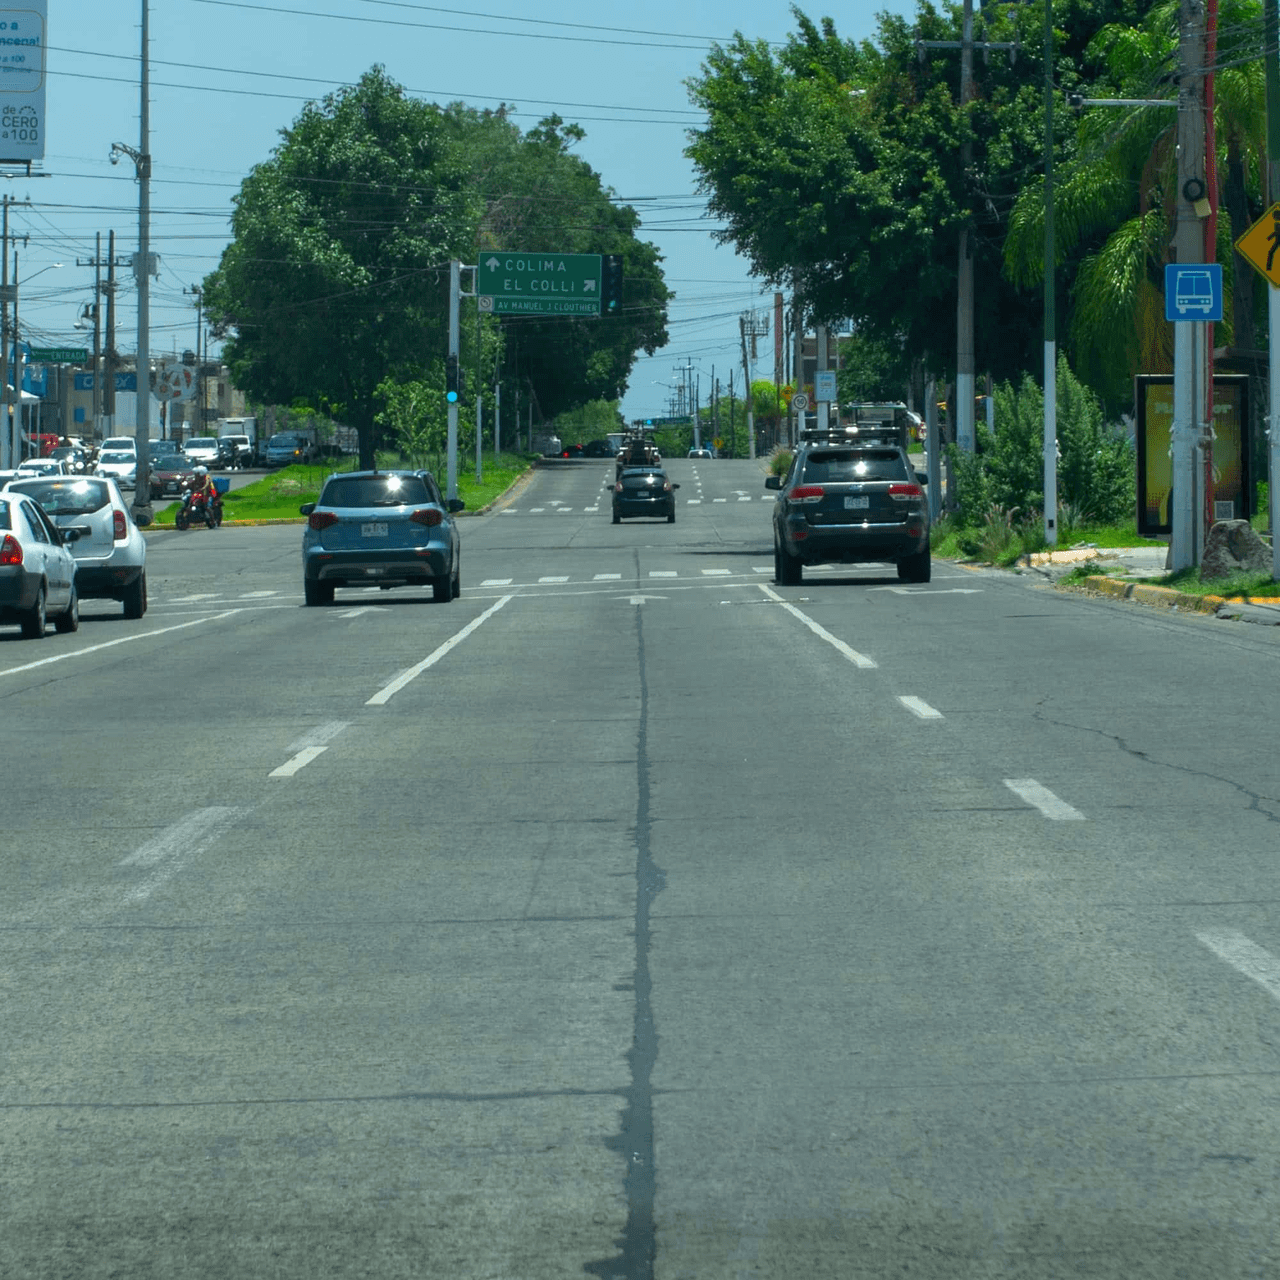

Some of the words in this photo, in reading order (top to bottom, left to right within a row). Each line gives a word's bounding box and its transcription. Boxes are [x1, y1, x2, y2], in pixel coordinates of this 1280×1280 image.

[10, 21, 19, 30] a
[2, 105, 17, 115] de
[505, 259, 567, 272] COLIMA
[504, 278, 523, 291] EL
[530, 279, 575, 292] COLLI
[497, 302, 509, 310] AV
[511, 302, 544, 311] MANUEL
[546, 303, 552, 311] J
[553, 303, 598, 312] CLOUTHIER
[50, 350, 87, 361] ENTRADA
